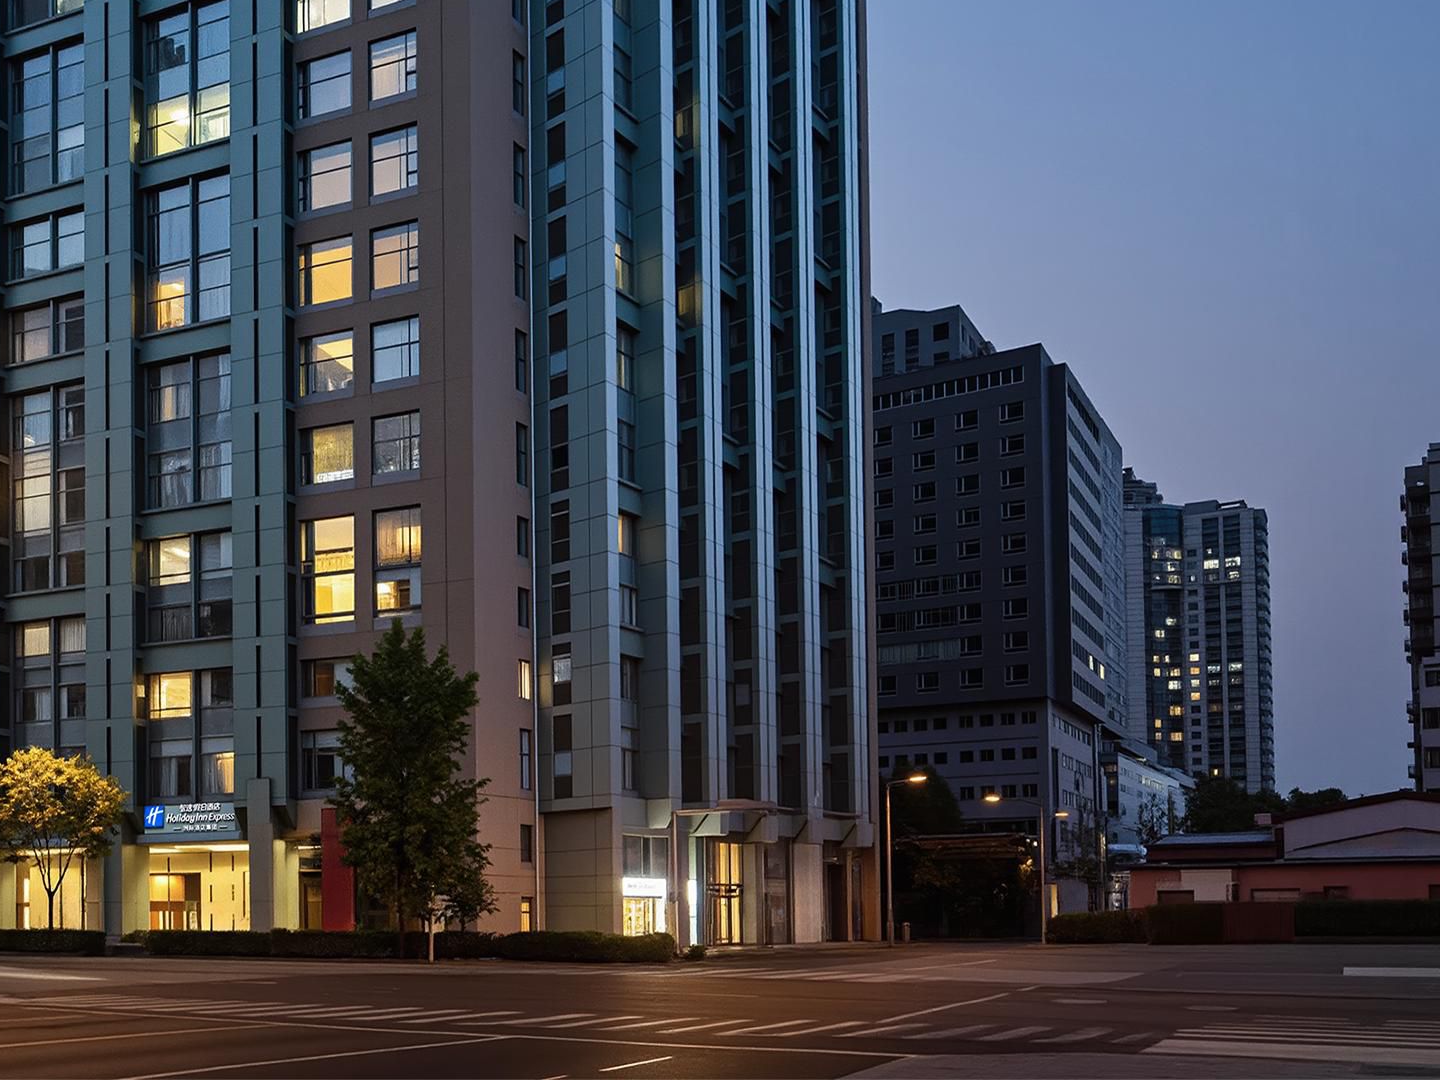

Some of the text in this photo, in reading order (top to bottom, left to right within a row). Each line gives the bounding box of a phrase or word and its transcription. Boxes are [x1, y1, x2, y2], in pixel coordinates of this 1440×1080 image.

[165, 812, 235, 824] Holiday Inn Express
